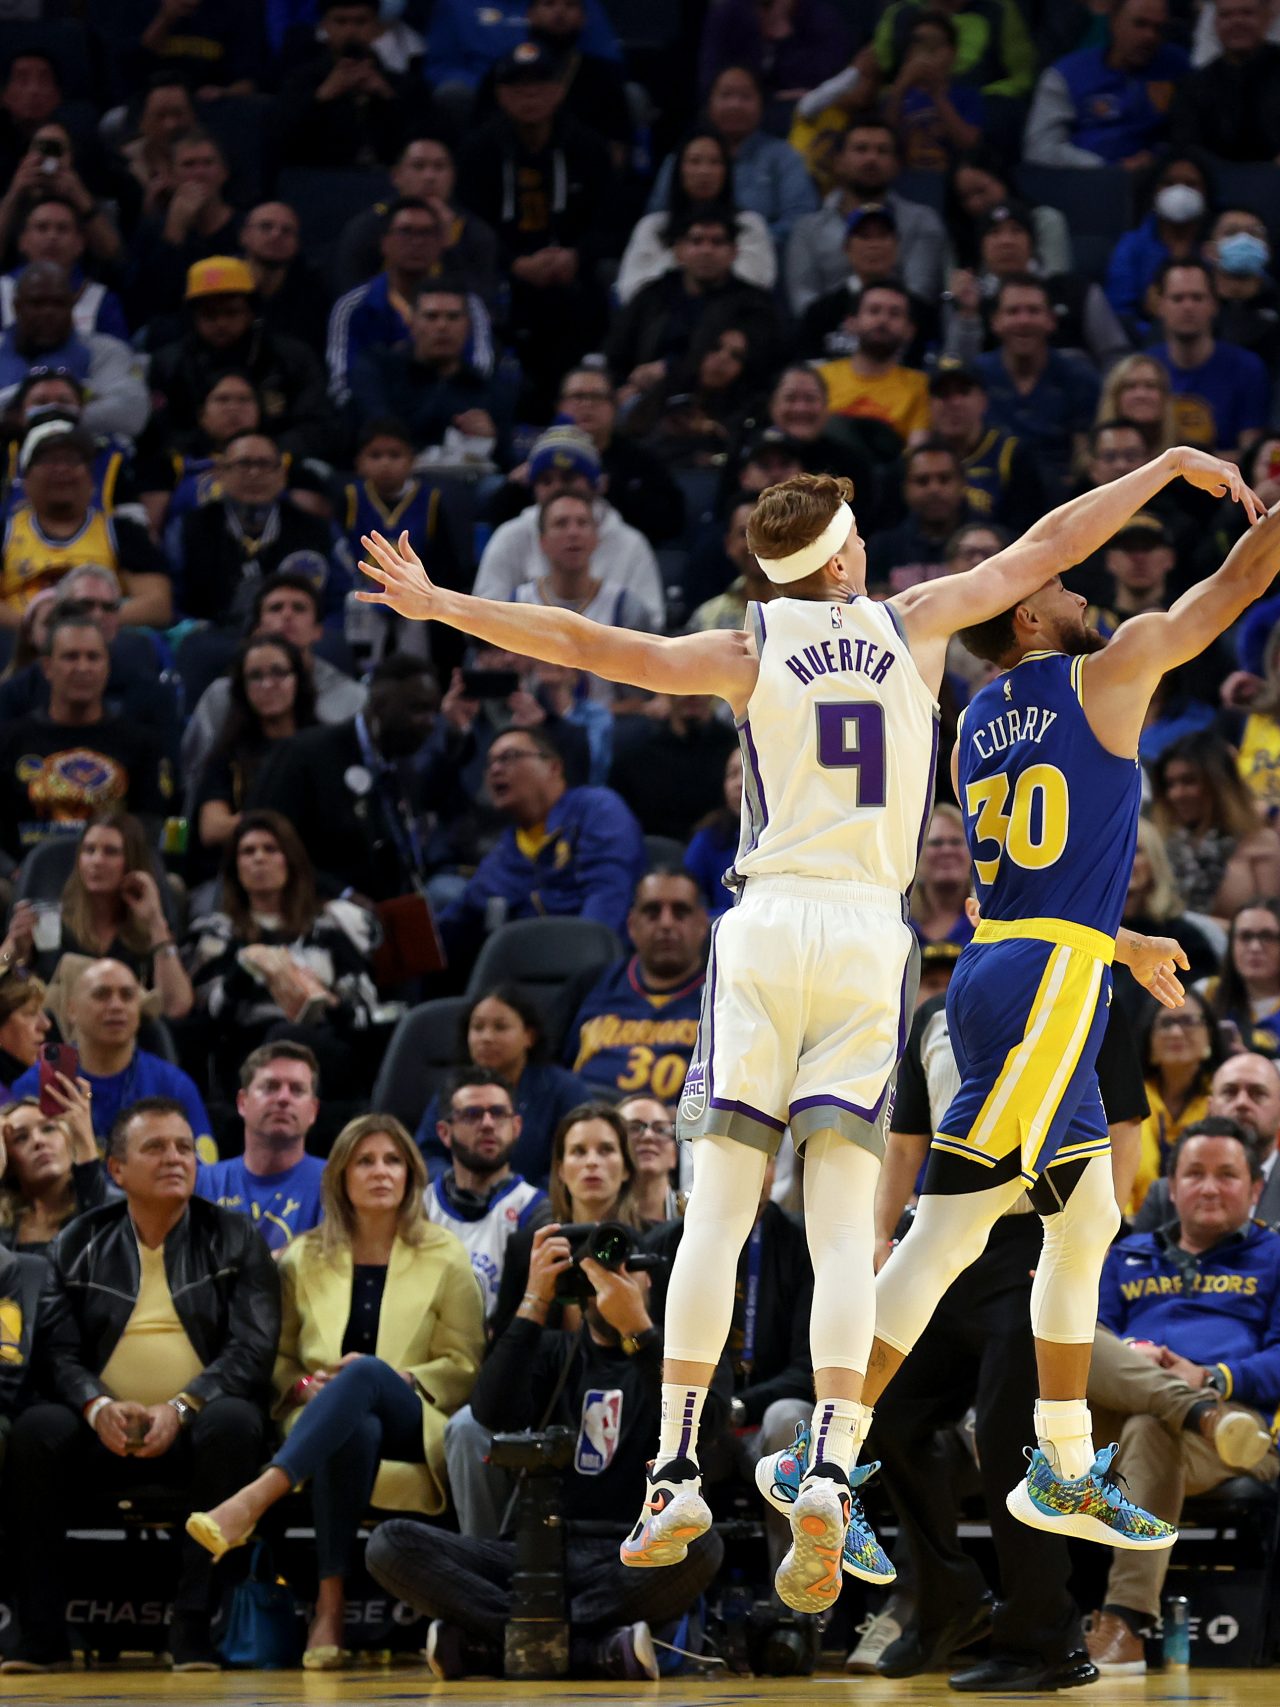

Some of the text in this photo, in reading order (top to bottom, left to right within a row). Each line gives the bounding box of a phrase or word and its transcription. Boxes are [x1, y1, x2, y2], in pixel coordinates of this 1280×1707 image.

[784, 638, 896, 686] HUERTER
[814, 700, 887, 808] 9
[973, 706, 1058, 759] CURRY
[963, 763, 1070, 886] 30
[616, 1046, 687, 1100] 30
[682, 1082, 705, 1097] SAC
